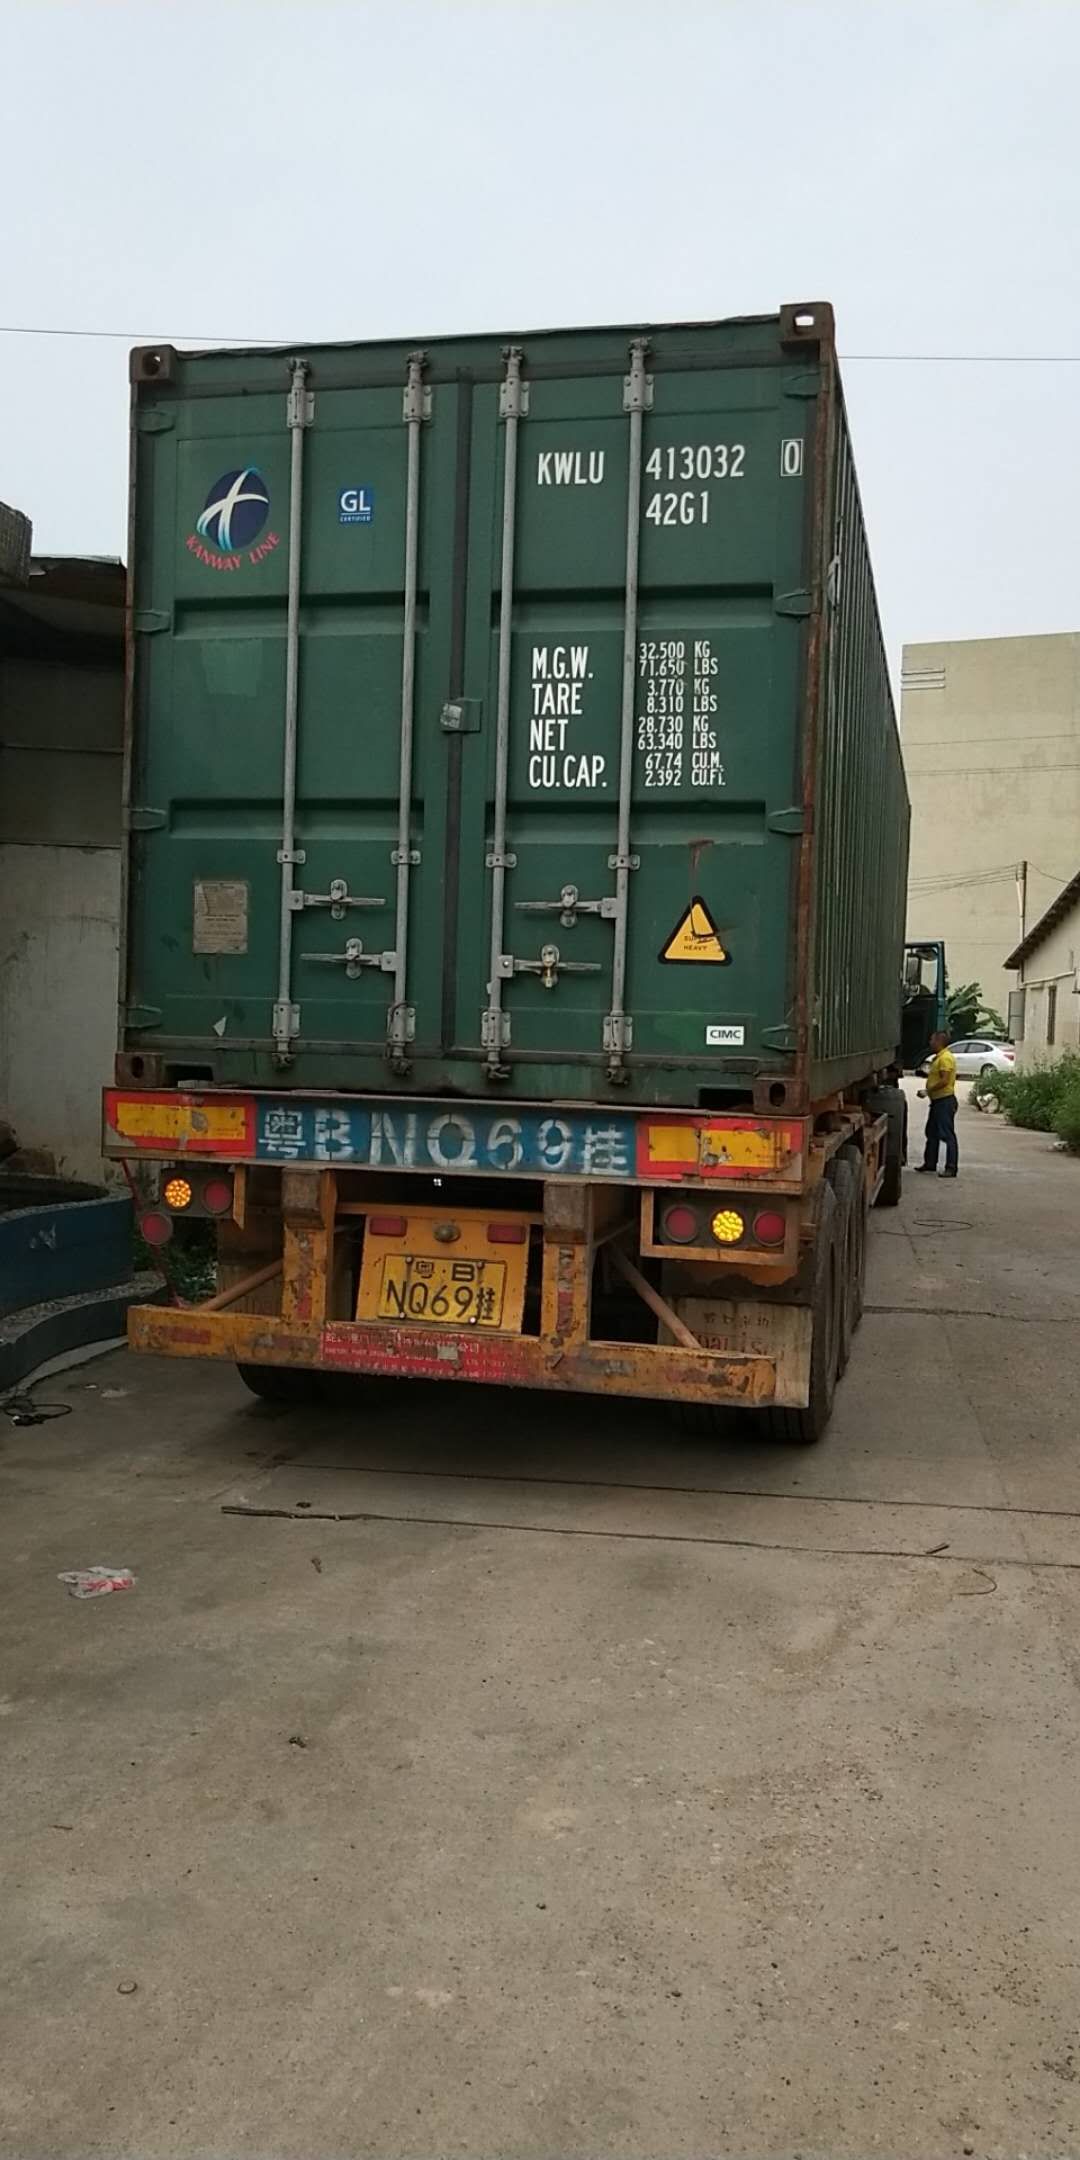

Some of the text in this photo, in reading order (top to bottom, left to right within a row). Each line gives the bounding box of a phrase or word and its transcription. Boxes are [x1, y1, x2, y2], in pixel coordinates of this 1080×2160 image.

[537, 440, 801, 485] KWLU 413032 0
[340, 490, 371, 512] GL
[645, 491, 709, 525] 42G1
[186, 531, 280, 571] KANWAY LINE
[532, 646, 594, 679] M.G.W.
[694, 640, 711, 657] KG
[694, 657, 719, 675] LBS
[532, 682, 583, 715] TARE
[694, 678, 710, 695] KG
[693, 694, 718, 713] LBS
[530, 719, 569, 751] NET
[692, 714, 709, 732] KG
[692, 731, 717, 749] LBS
[529, 751, 723, 787] CU.CAP. 67.74 CU.M.
[709, 1029, 742, 1040] CIMC
[258, 1108, 630, 1175] 粤BNQ69挂
[384, 1278, 496, 1321] NQ69挂
